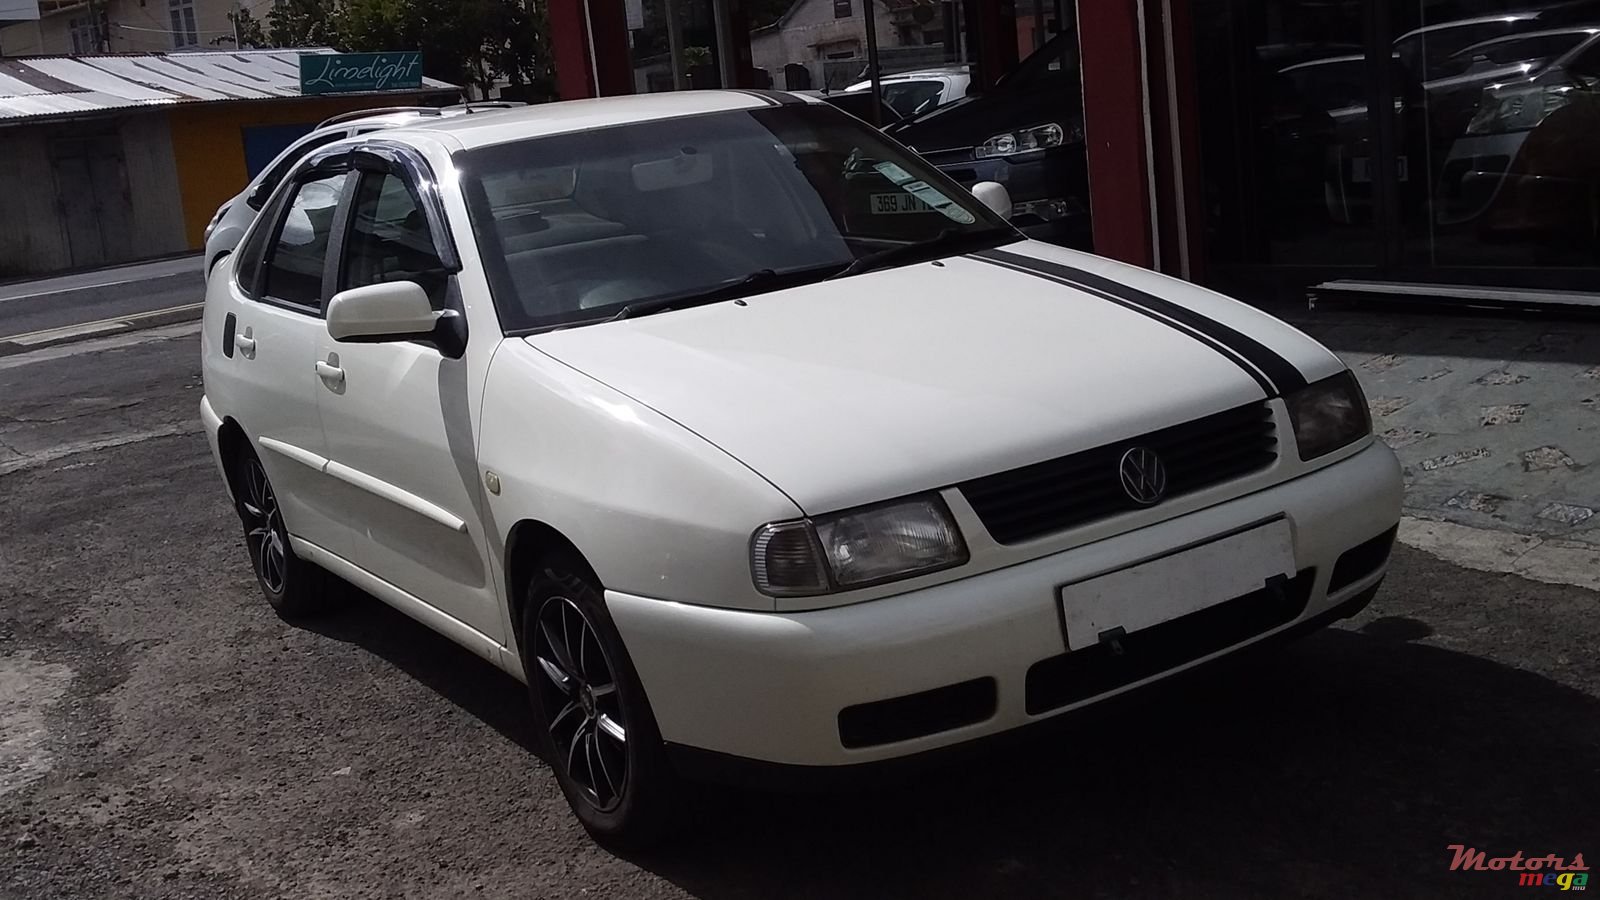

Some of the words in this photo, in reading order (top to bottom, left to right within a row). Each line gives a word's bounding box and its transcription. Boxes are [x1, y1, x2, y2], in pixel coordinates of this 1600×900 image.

[304, 54, 419, 89] Limelight
[876, 195, 897, 212] 369
[902, 195, 916, 211] JN
